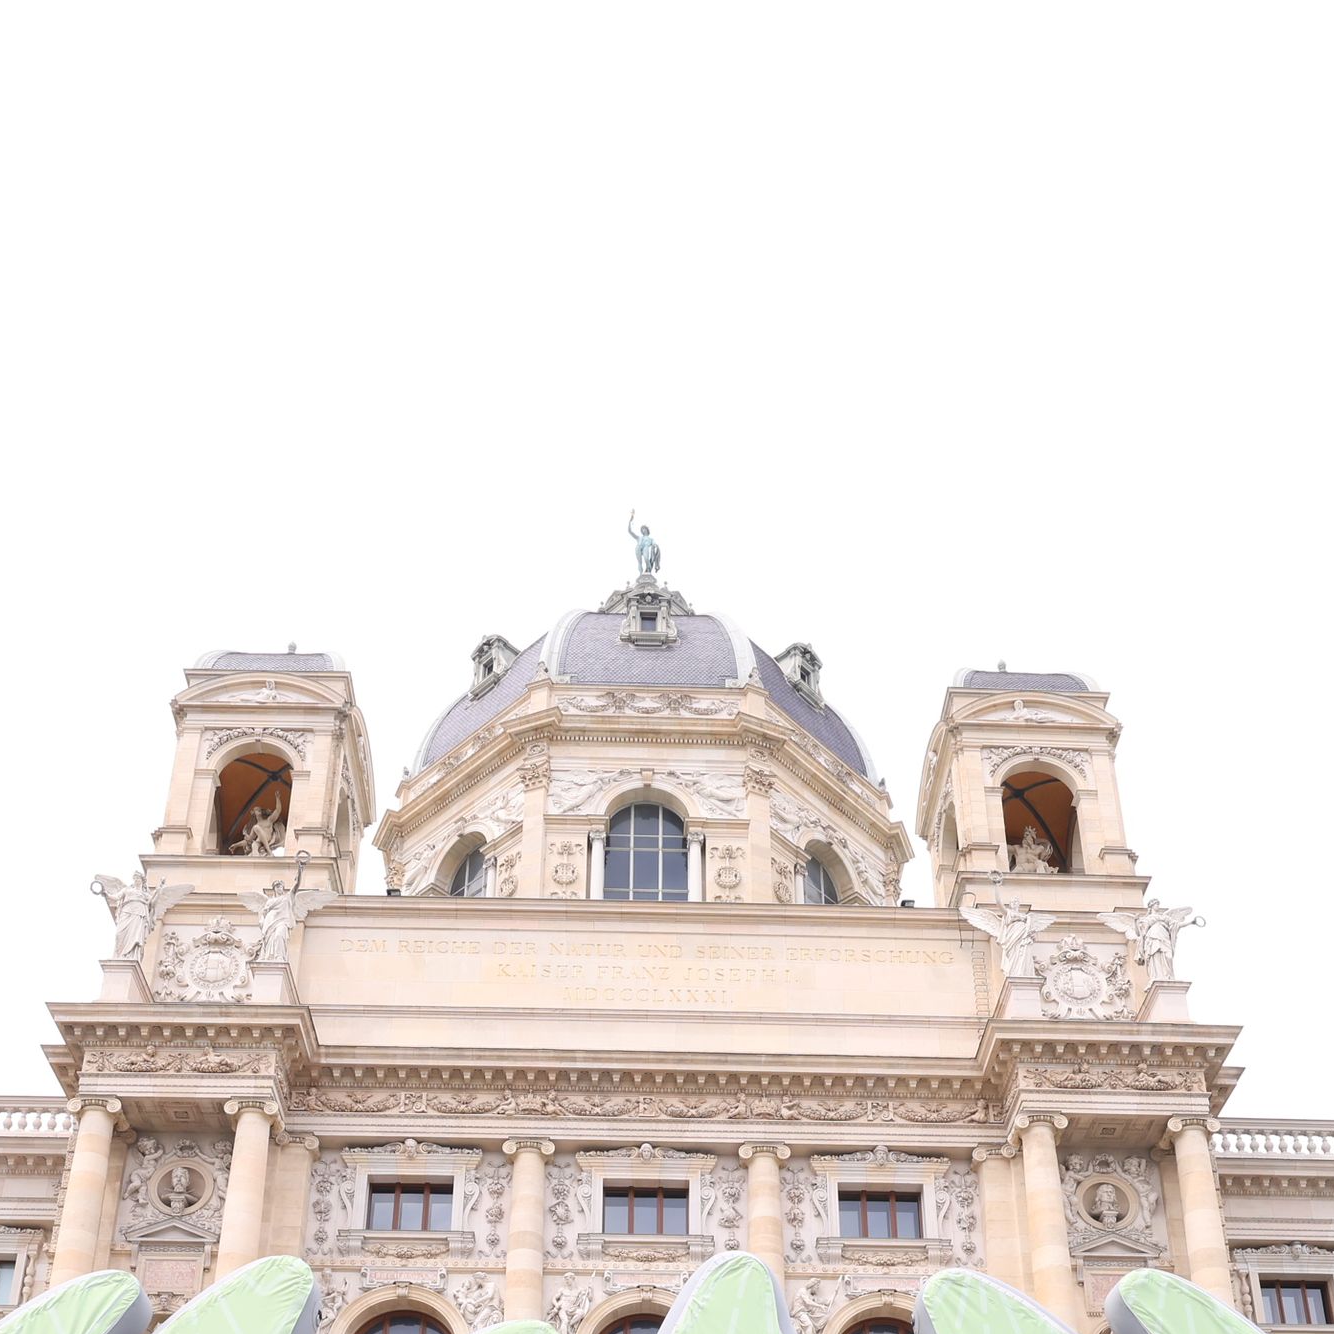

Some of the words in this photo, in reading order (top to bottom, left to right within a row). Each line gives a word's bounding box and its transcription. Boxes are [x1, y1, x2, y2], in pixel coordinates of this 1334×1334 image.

[339, 938, 388, 953] DEM
[397, 939, 481, 955] REICHE
[493, 941, 539, 956] DER
[549, 942, 627, 958] NATUR
[639, 944, 683, 959] UND
[696, 945, 775, 961] SEINER
[786, 946, 955, 965] ERFORSCHUNG
[497, 963, 584, 979] KAISER
[597, 965, 670, 980] FRANZ
[682, 967, 777, 982] JOSEPH
[563, 986, 734, 1004] MDCCCLXXXI.
